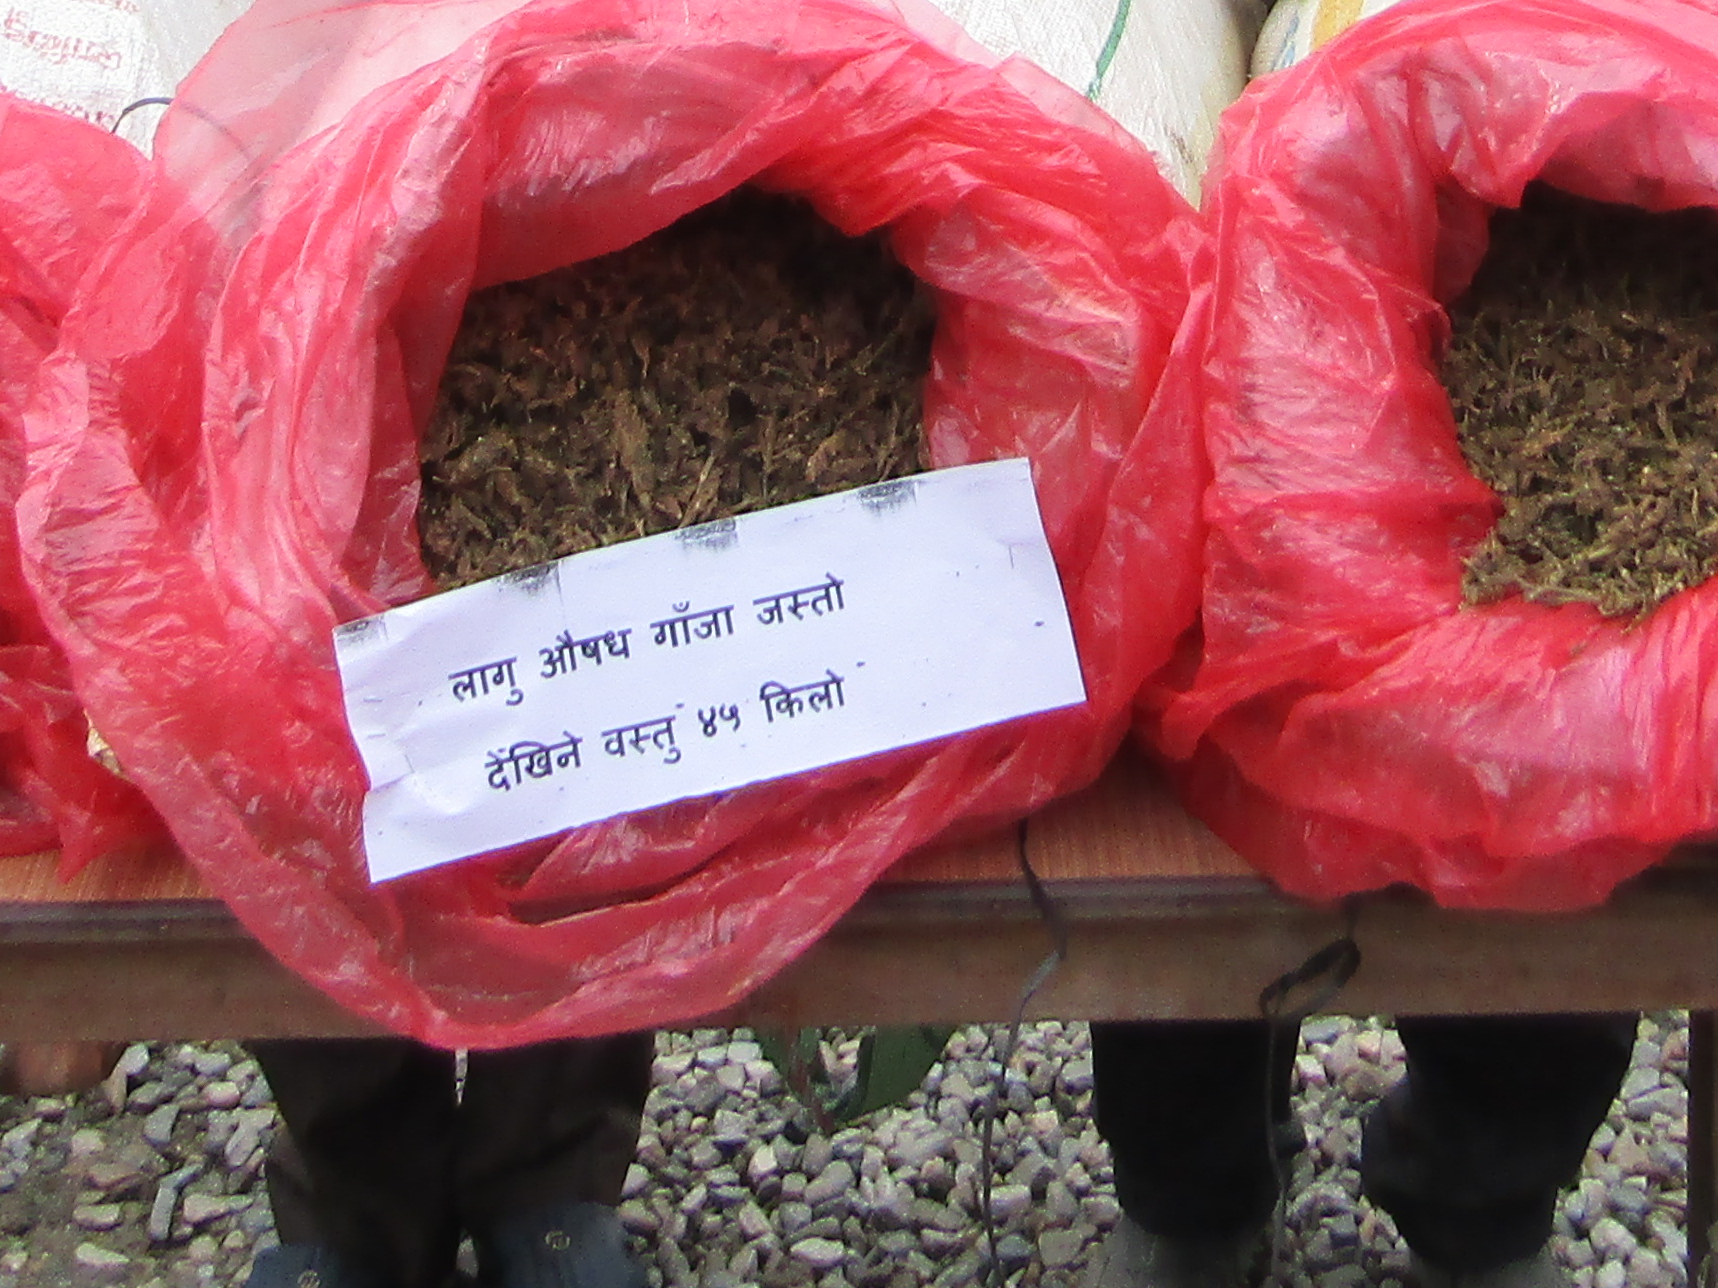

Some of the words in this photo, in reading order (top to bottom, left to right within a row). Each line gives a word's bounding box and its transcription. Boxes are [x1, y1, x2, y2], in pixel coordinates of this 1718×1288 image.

[448, 656, 524, 706] लागु
[538, 628, 632, 678] औषध
[649, 600, 734, 648] गाँजा
[752, 571, 844, 624] जस्तो
[697, 703, 741, 738] ४५
[759, 668, 845, 723] किलो
